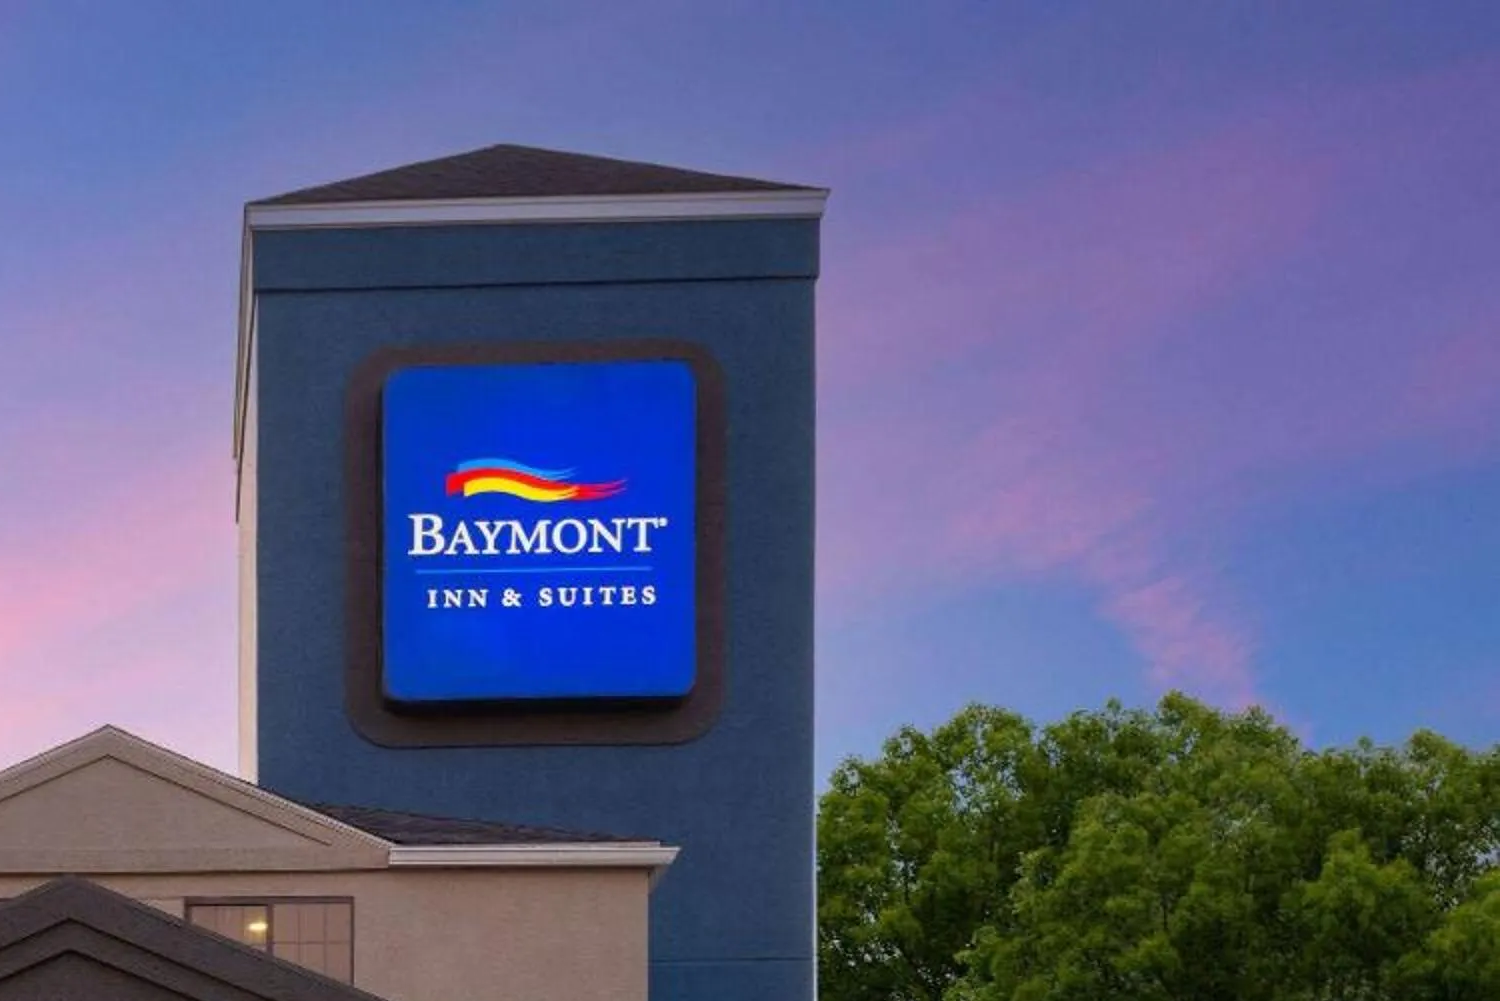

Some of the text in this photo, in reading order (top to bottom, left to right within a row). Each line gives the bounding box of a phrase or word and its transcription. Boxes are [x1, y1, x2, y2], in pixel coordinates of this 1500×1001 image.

[408, 513, 659, 556] BAYMONT
[427, 586, 657, 608] INN & SUITES
